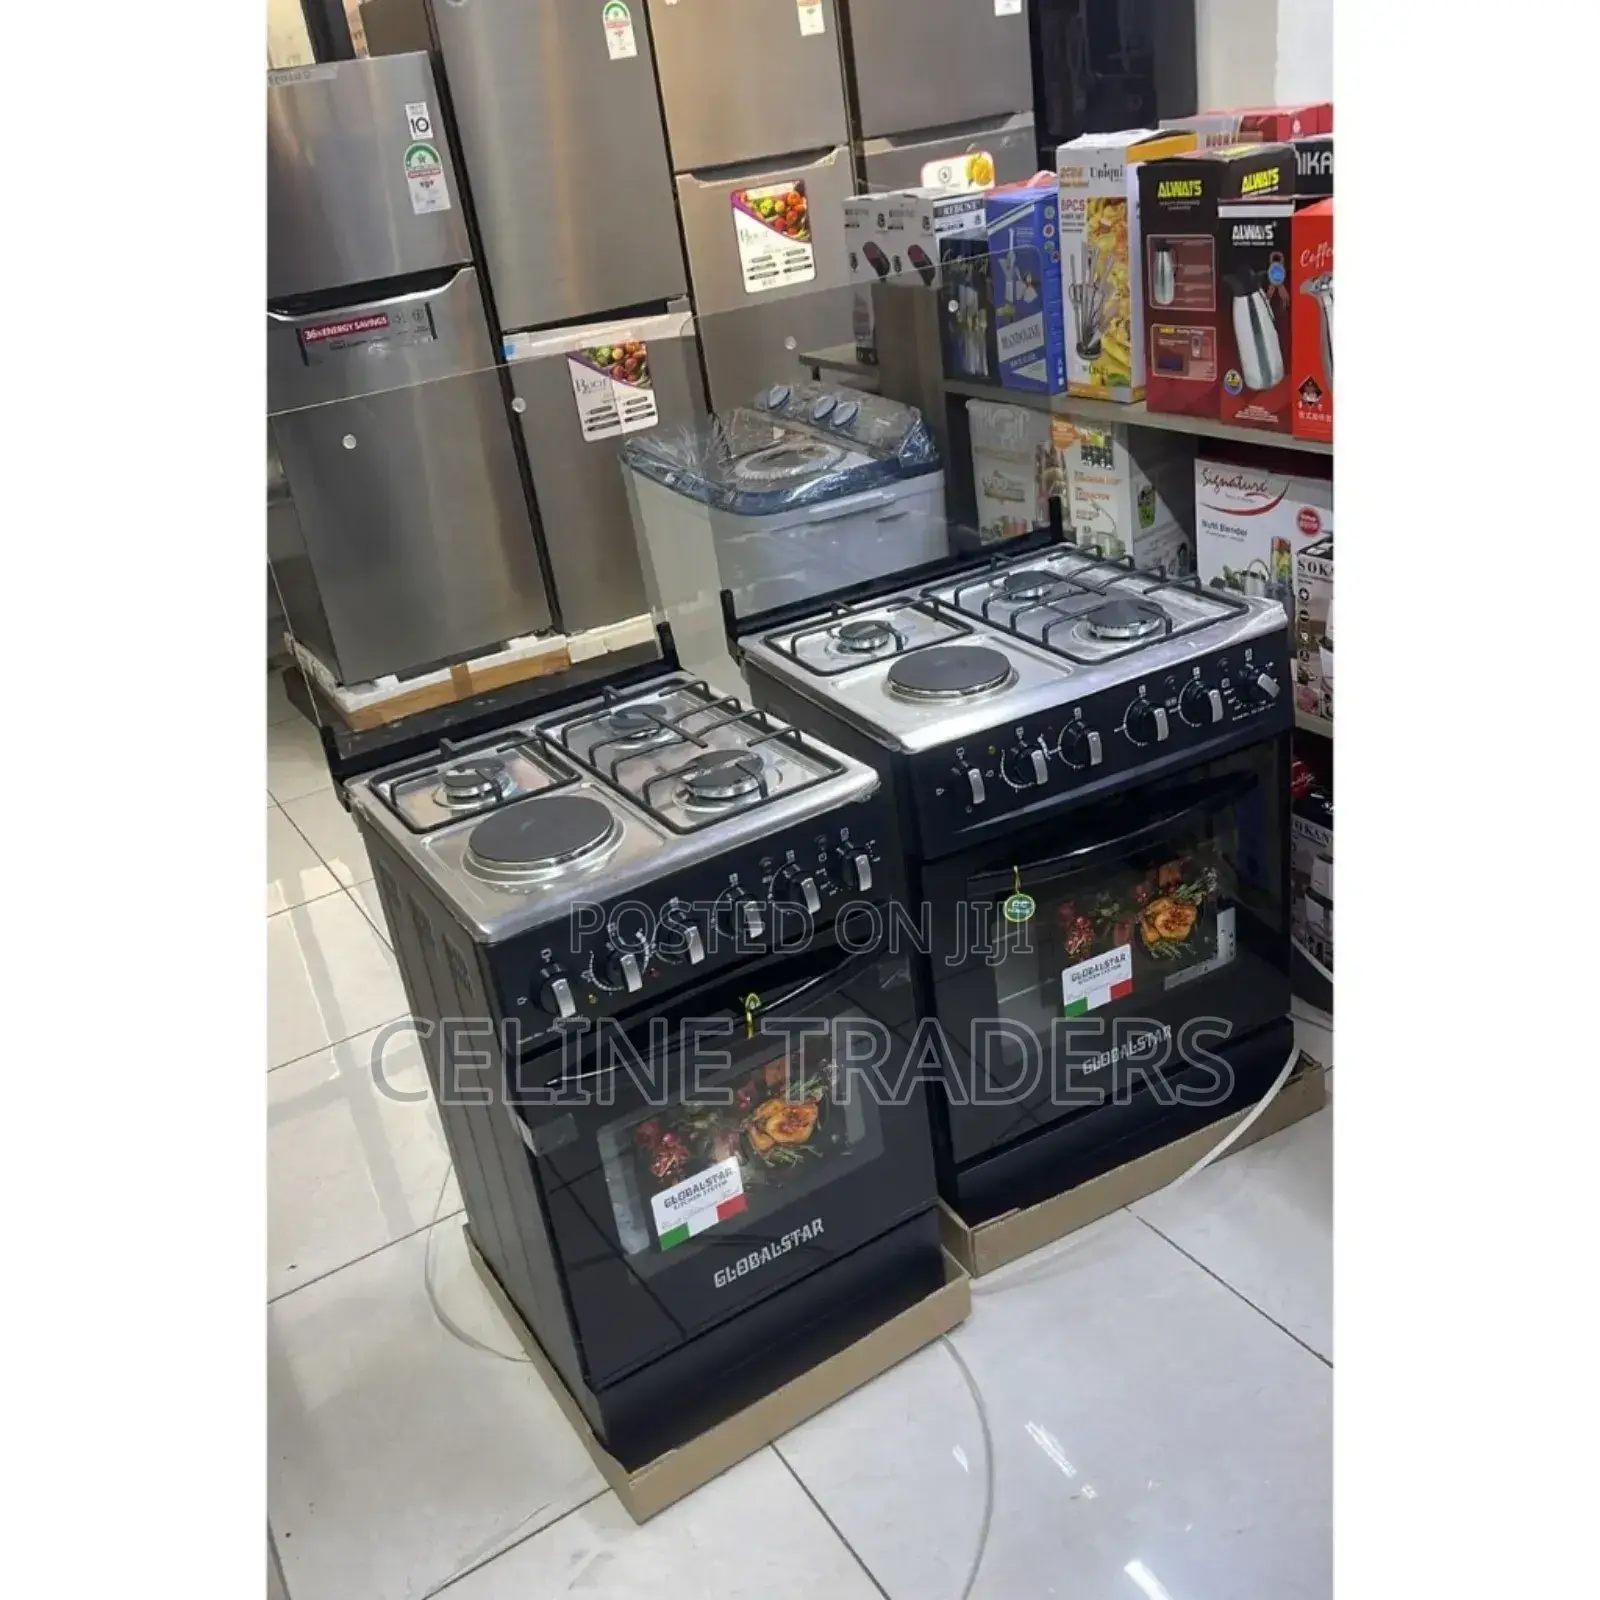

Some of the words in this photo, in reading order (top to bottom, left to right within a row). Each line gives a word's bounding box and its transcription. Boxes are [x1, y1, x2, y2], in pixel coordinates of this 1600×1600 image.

[1296, 150, 1333, 176] IKA
[1157, 180, 1203, 199] ALWAYS
[1232, 224, 1274, 241] ALWAYS
[354, 316, 388, 330] SAVINGS
[1201, 467, 1268, 495] Signature
[1298, 560, 1333, 577] SOK
[1071, 953, 1127, 982] GLOBALSTAR
[1081, 1024, 1173, 1076] GLOBALSTAR
[663, 1167, 733, 1209] GLOBALSTAR
[713, 1217, 825, 1289] GLOBALSTAR
